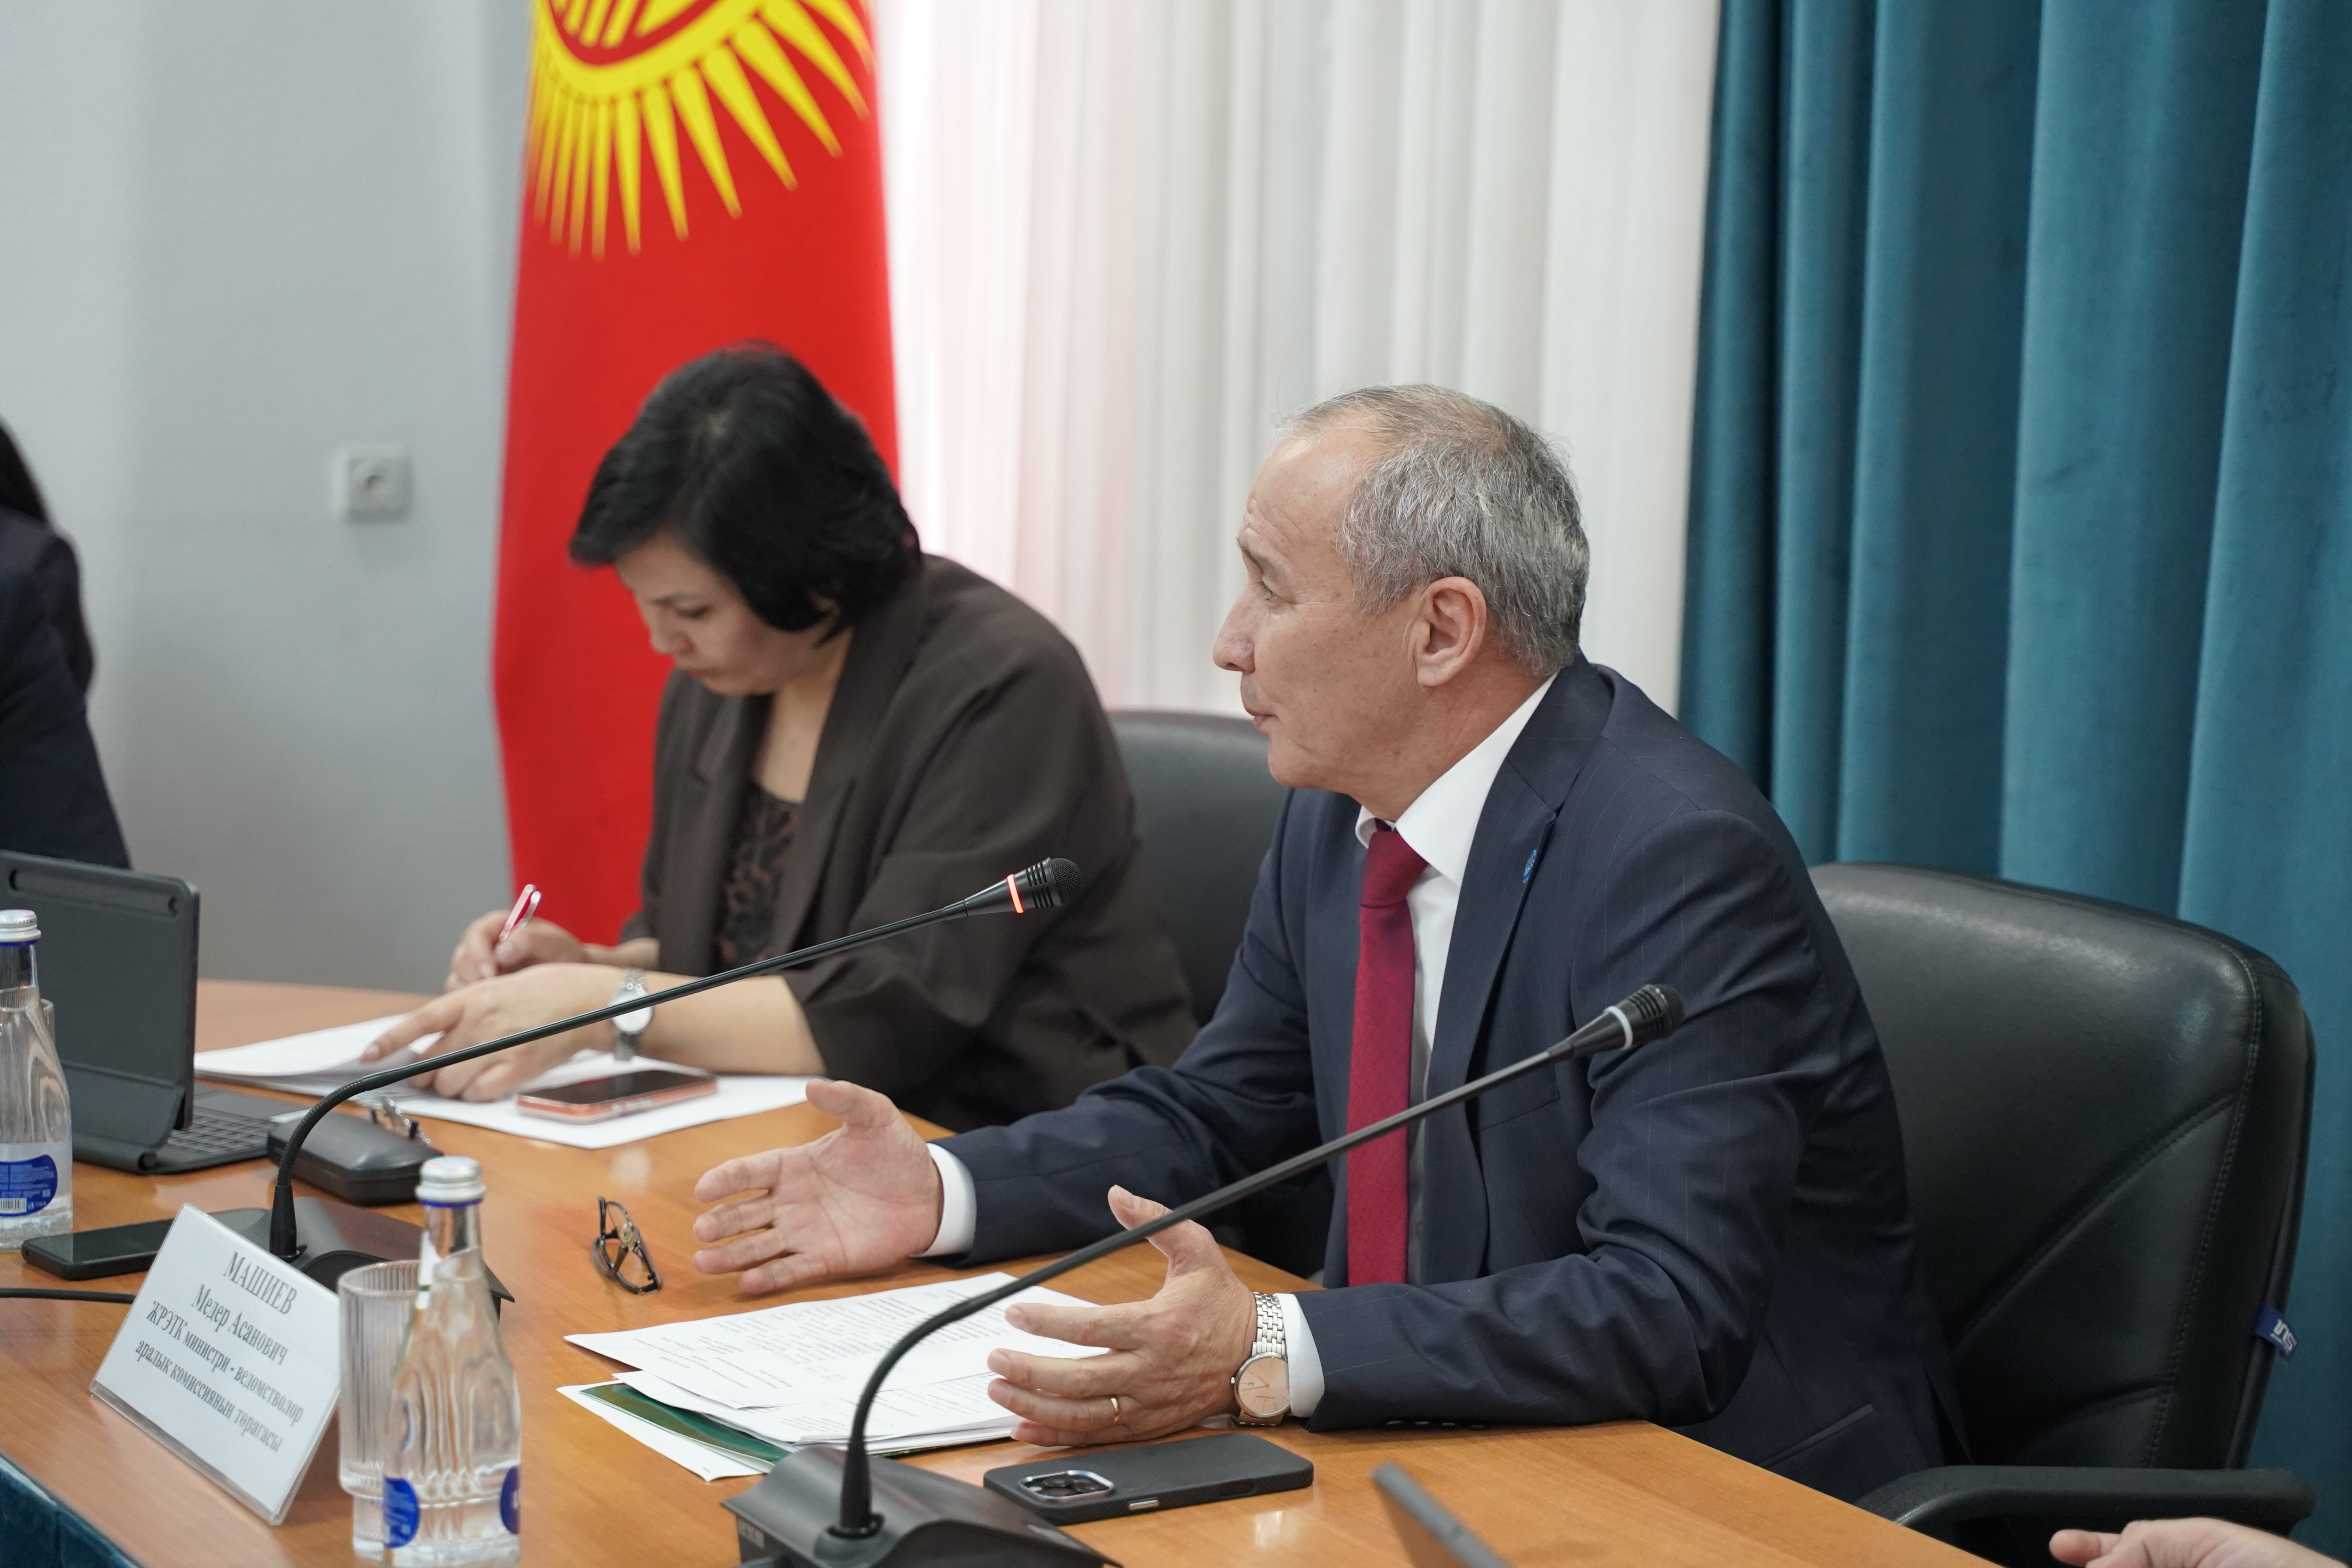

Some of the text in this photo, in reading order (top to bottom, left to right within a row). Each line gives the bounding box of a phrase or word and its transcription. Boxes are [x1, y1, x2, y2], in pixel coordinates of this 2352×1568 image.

[191, 1284, 289, 1365] Медер Асанович
[223, 1251, 297, 1314] МАШИЕВ
[136, 1341, 283, 1452] аралык комиссиянын төрагасы
[146, 1300, 188, 1341] ЖРЭТК
[183, 1331, 231, 1372] министри
[234, 1366, 304, 1427] ведомстволор
